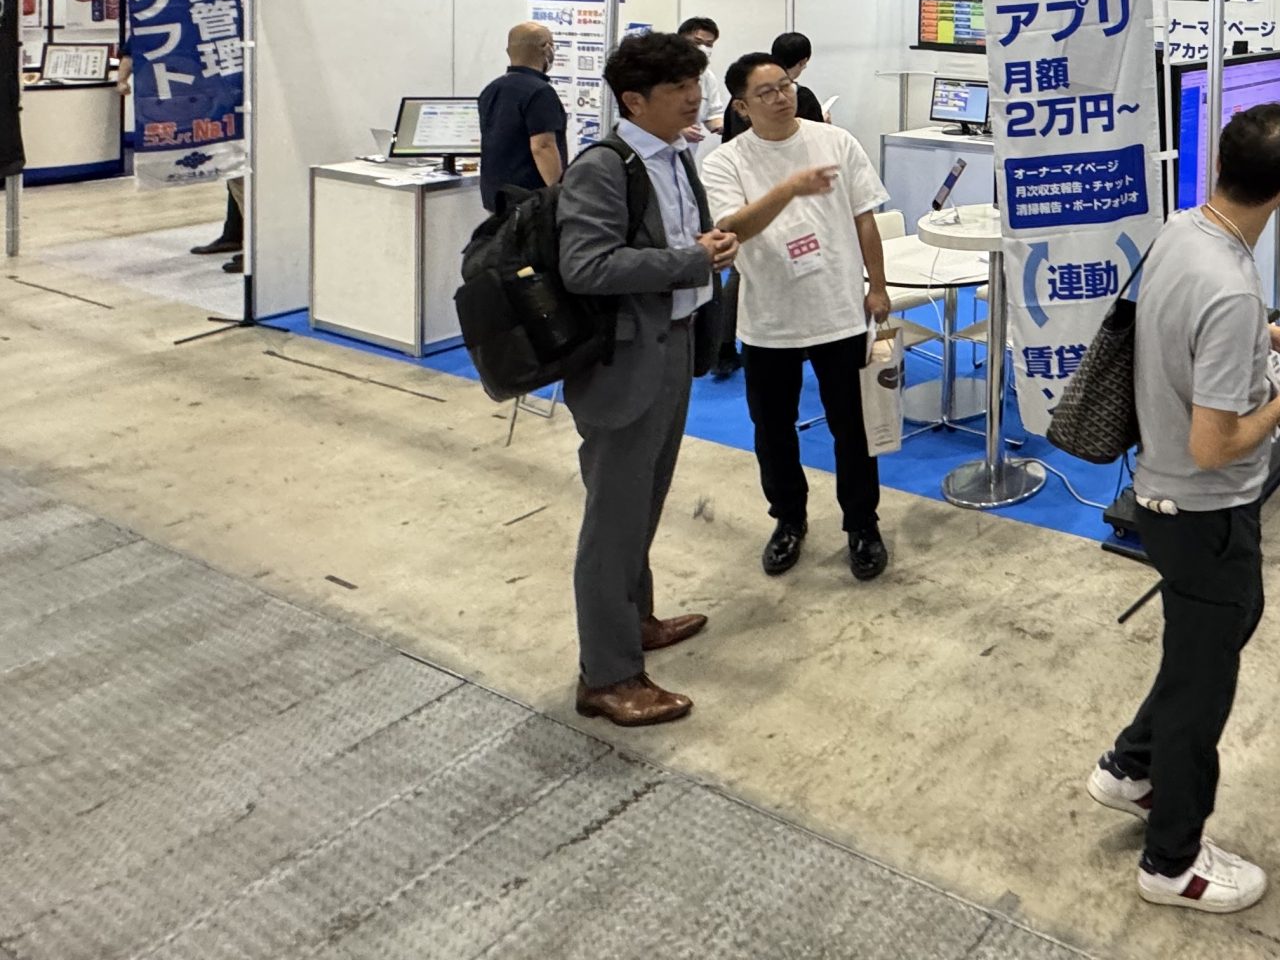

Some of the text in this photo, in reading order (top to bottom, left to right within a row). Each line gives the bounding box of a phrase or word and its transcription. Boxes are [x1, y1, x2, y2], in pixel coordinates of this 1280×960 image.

[1003, 56, 1070, 94] 月額
[1013, 159, 1120, 180] オーナーマイページ
[1015, 174, 1135, 199] 月次収支報告・チャット
[1015, 191, 1140, 217] 清掃報告・ポートフォリオ
[1047, 260, 1119, 301] 連動
[1022, 343, 1088, 380] 賃貸
